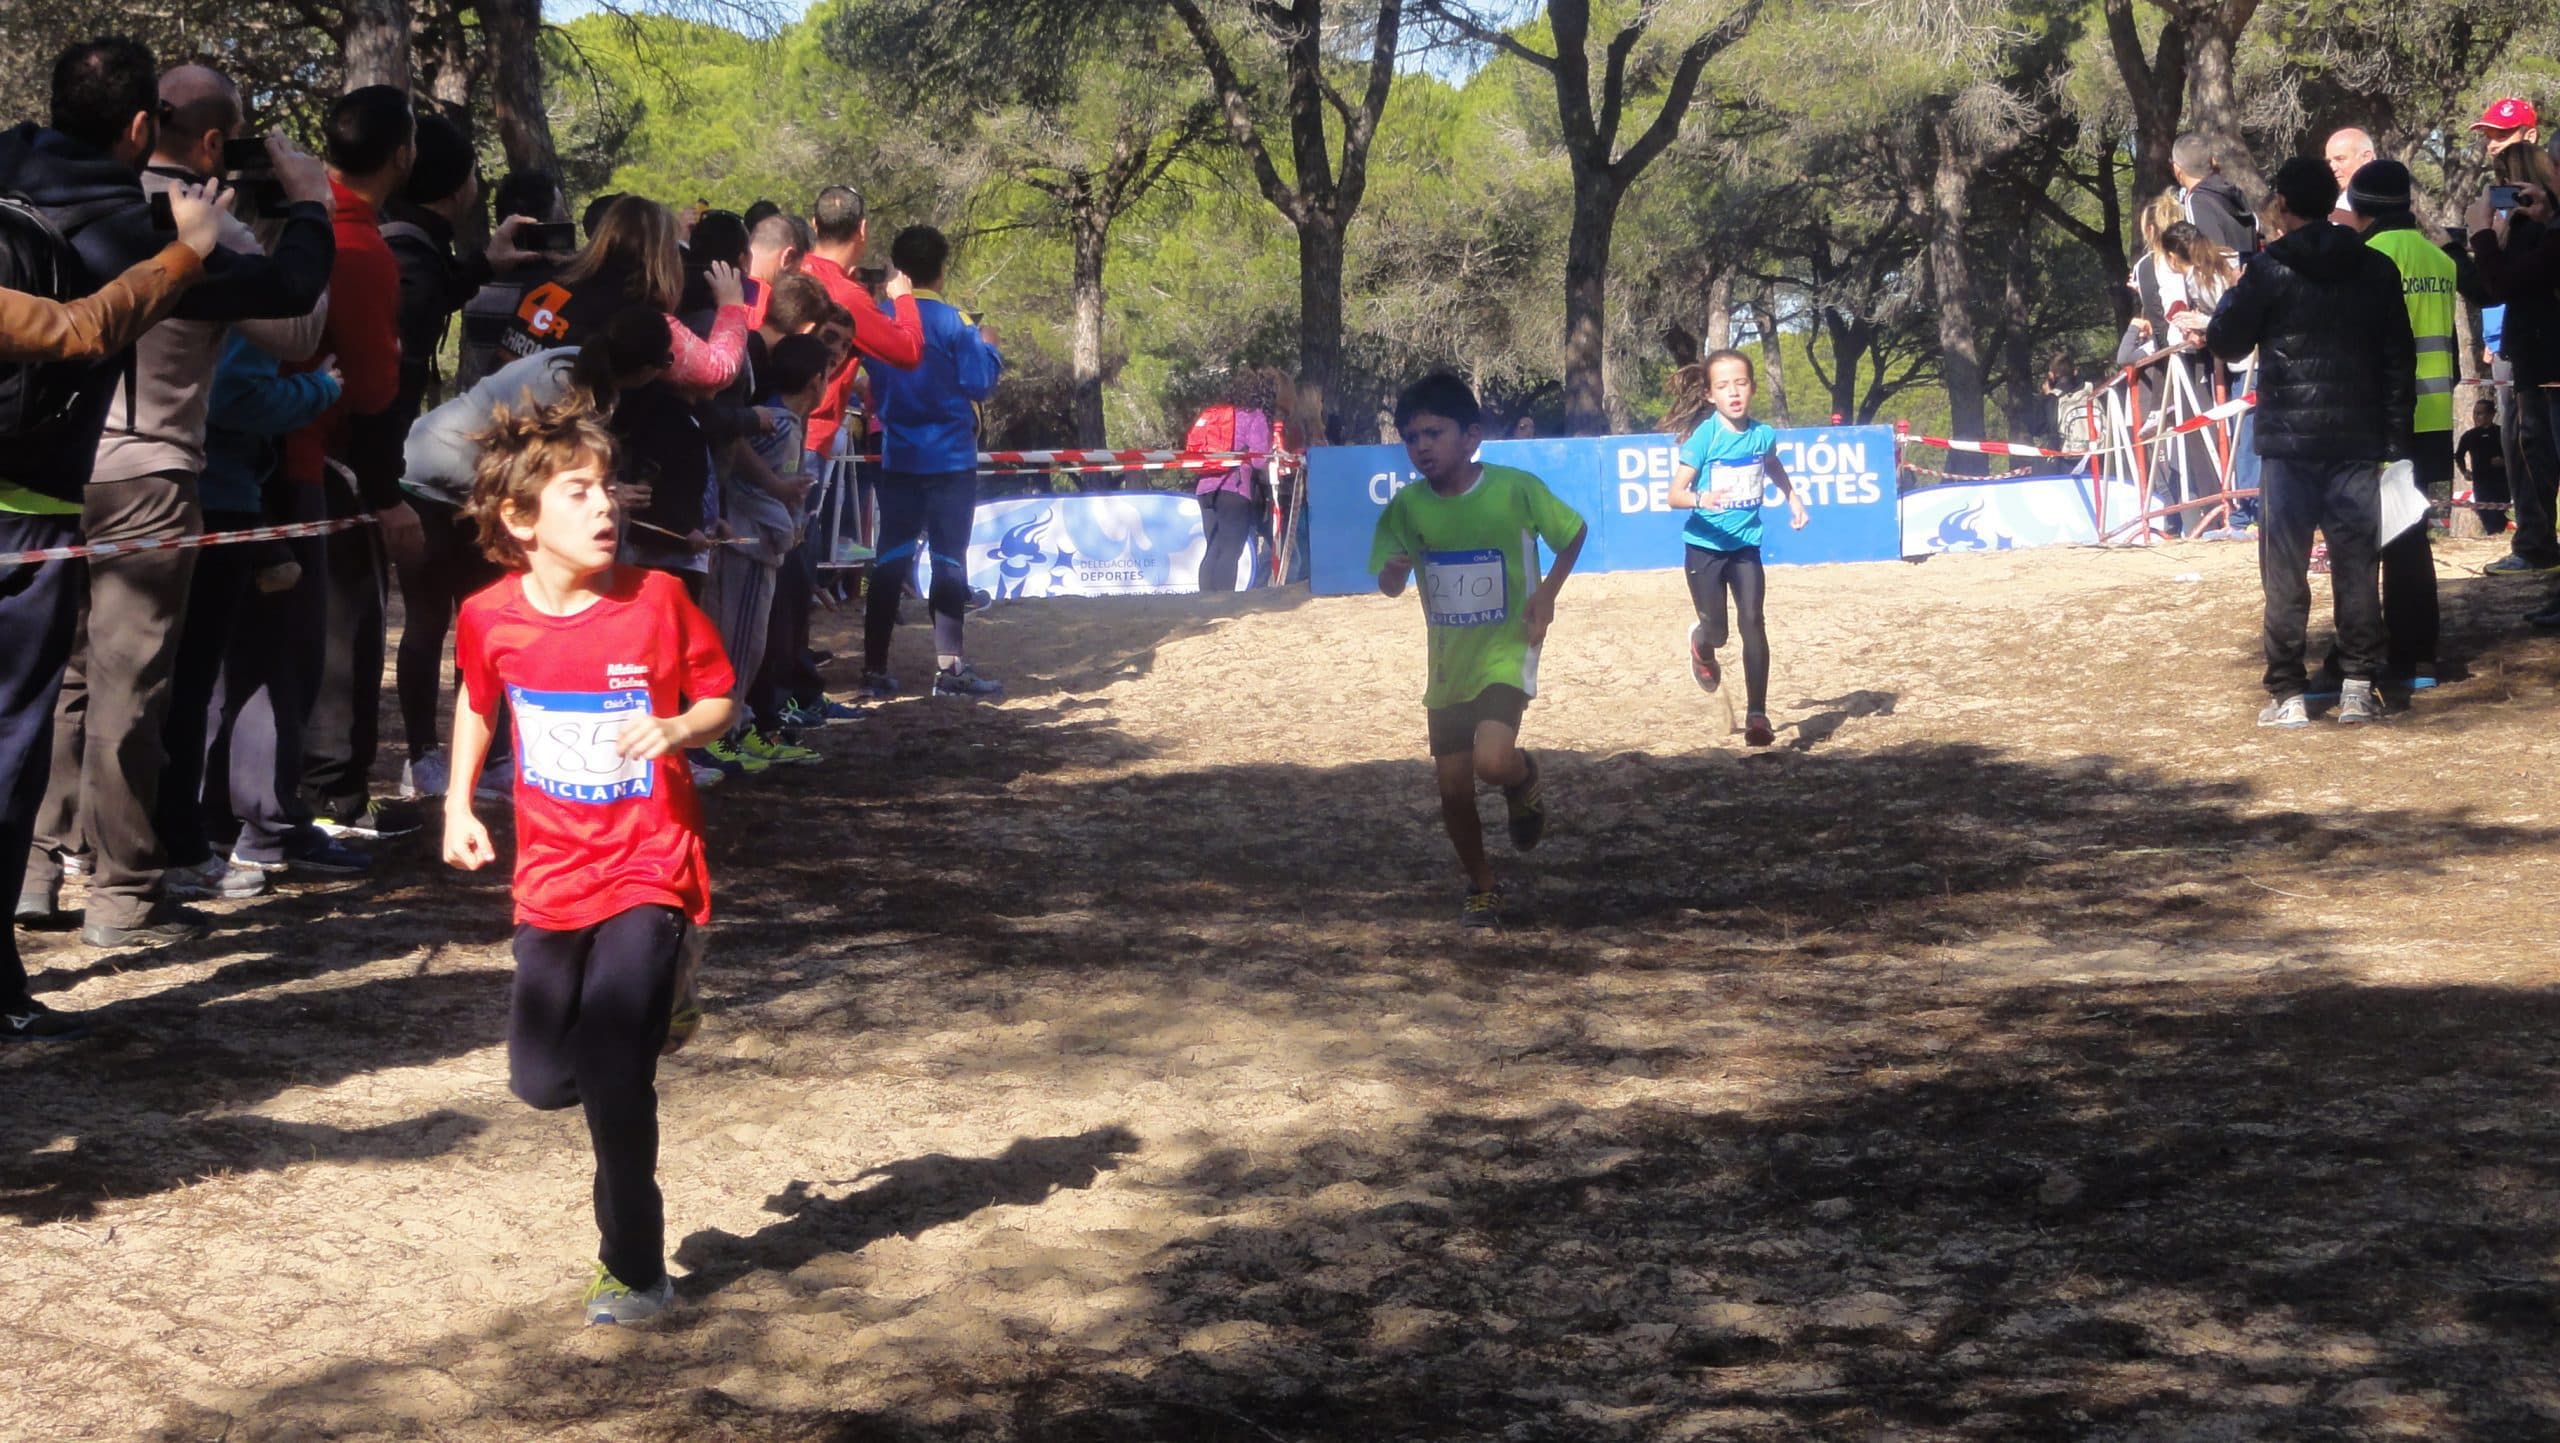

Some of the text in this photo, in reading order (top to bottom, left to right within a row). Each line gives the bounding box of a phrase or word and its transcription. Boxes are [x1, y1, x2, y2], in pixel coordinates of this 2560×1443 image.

[1080, 571, 1145, 582] DEPORTES
[1430, 574, 1493, 598] 210
[524, 767, 647, 800] CHICLANA
